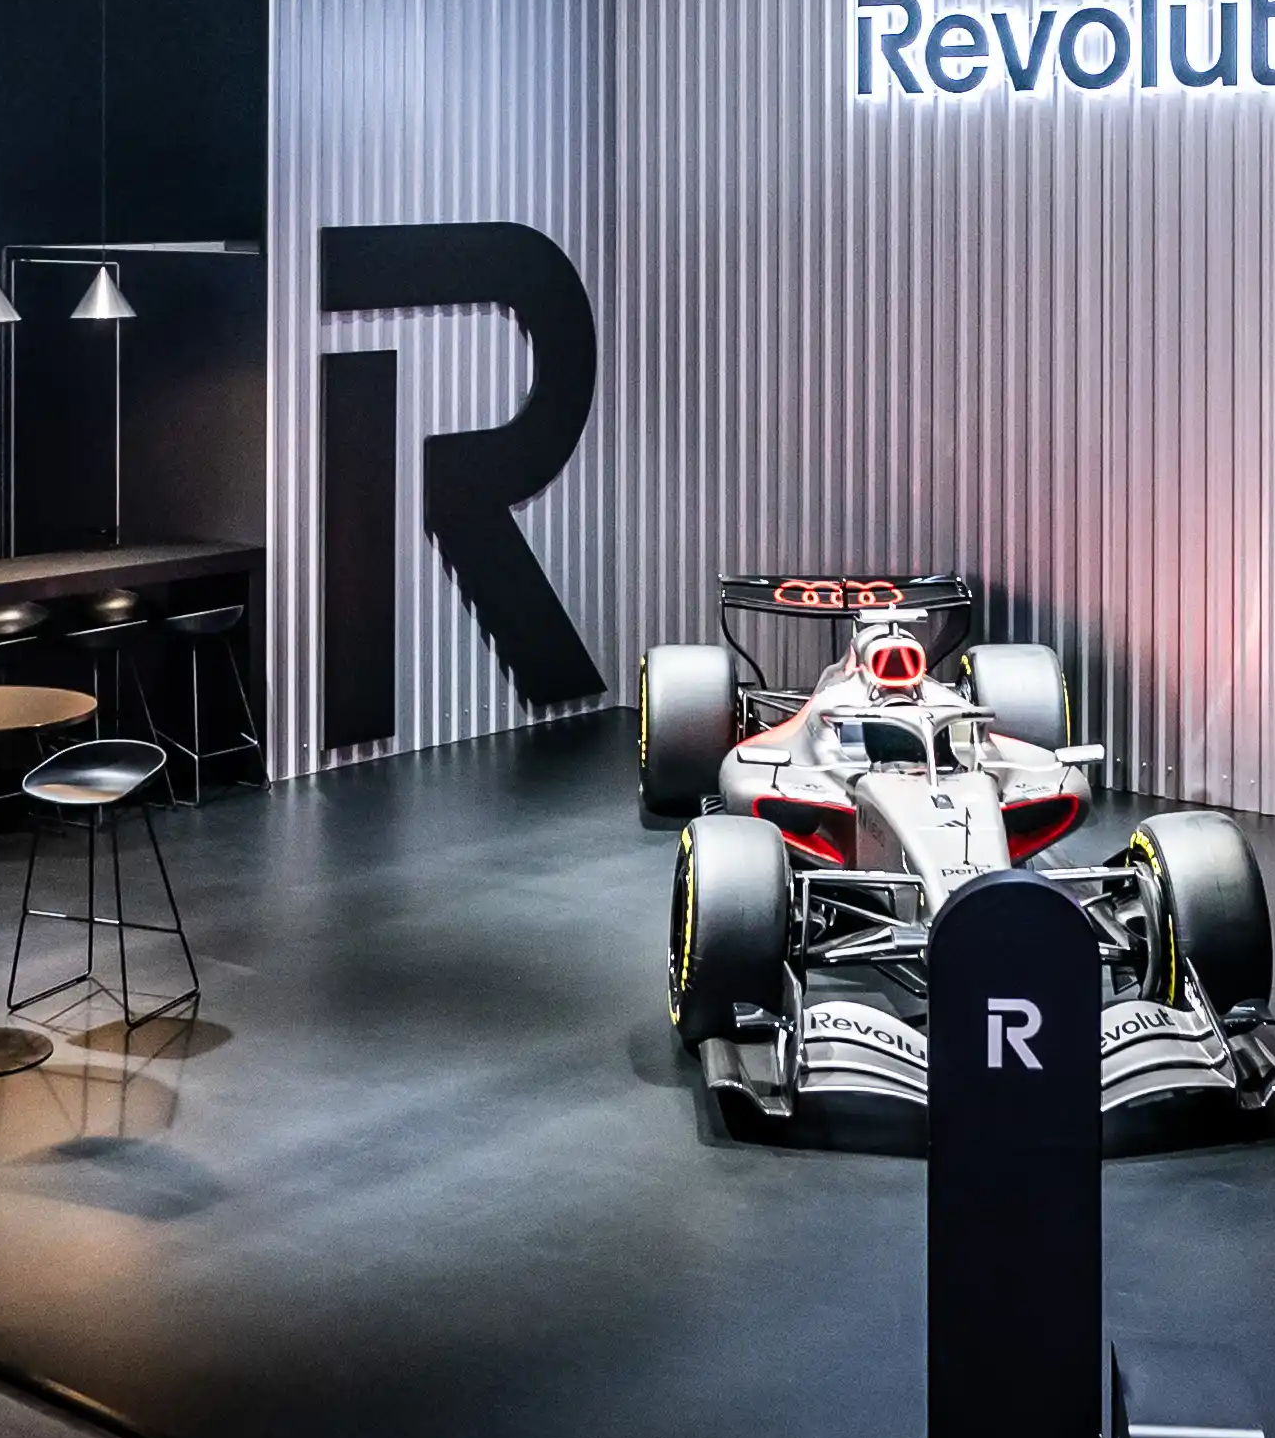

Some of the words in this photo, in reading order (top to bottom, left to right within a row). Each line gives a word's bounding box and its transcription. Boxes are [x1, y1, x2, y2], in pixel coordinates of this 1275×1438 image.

[320, 221, 609, 751] R
[810, 1011, 926, 1061] Revolu
[987, 997, 1044, 1070] R
